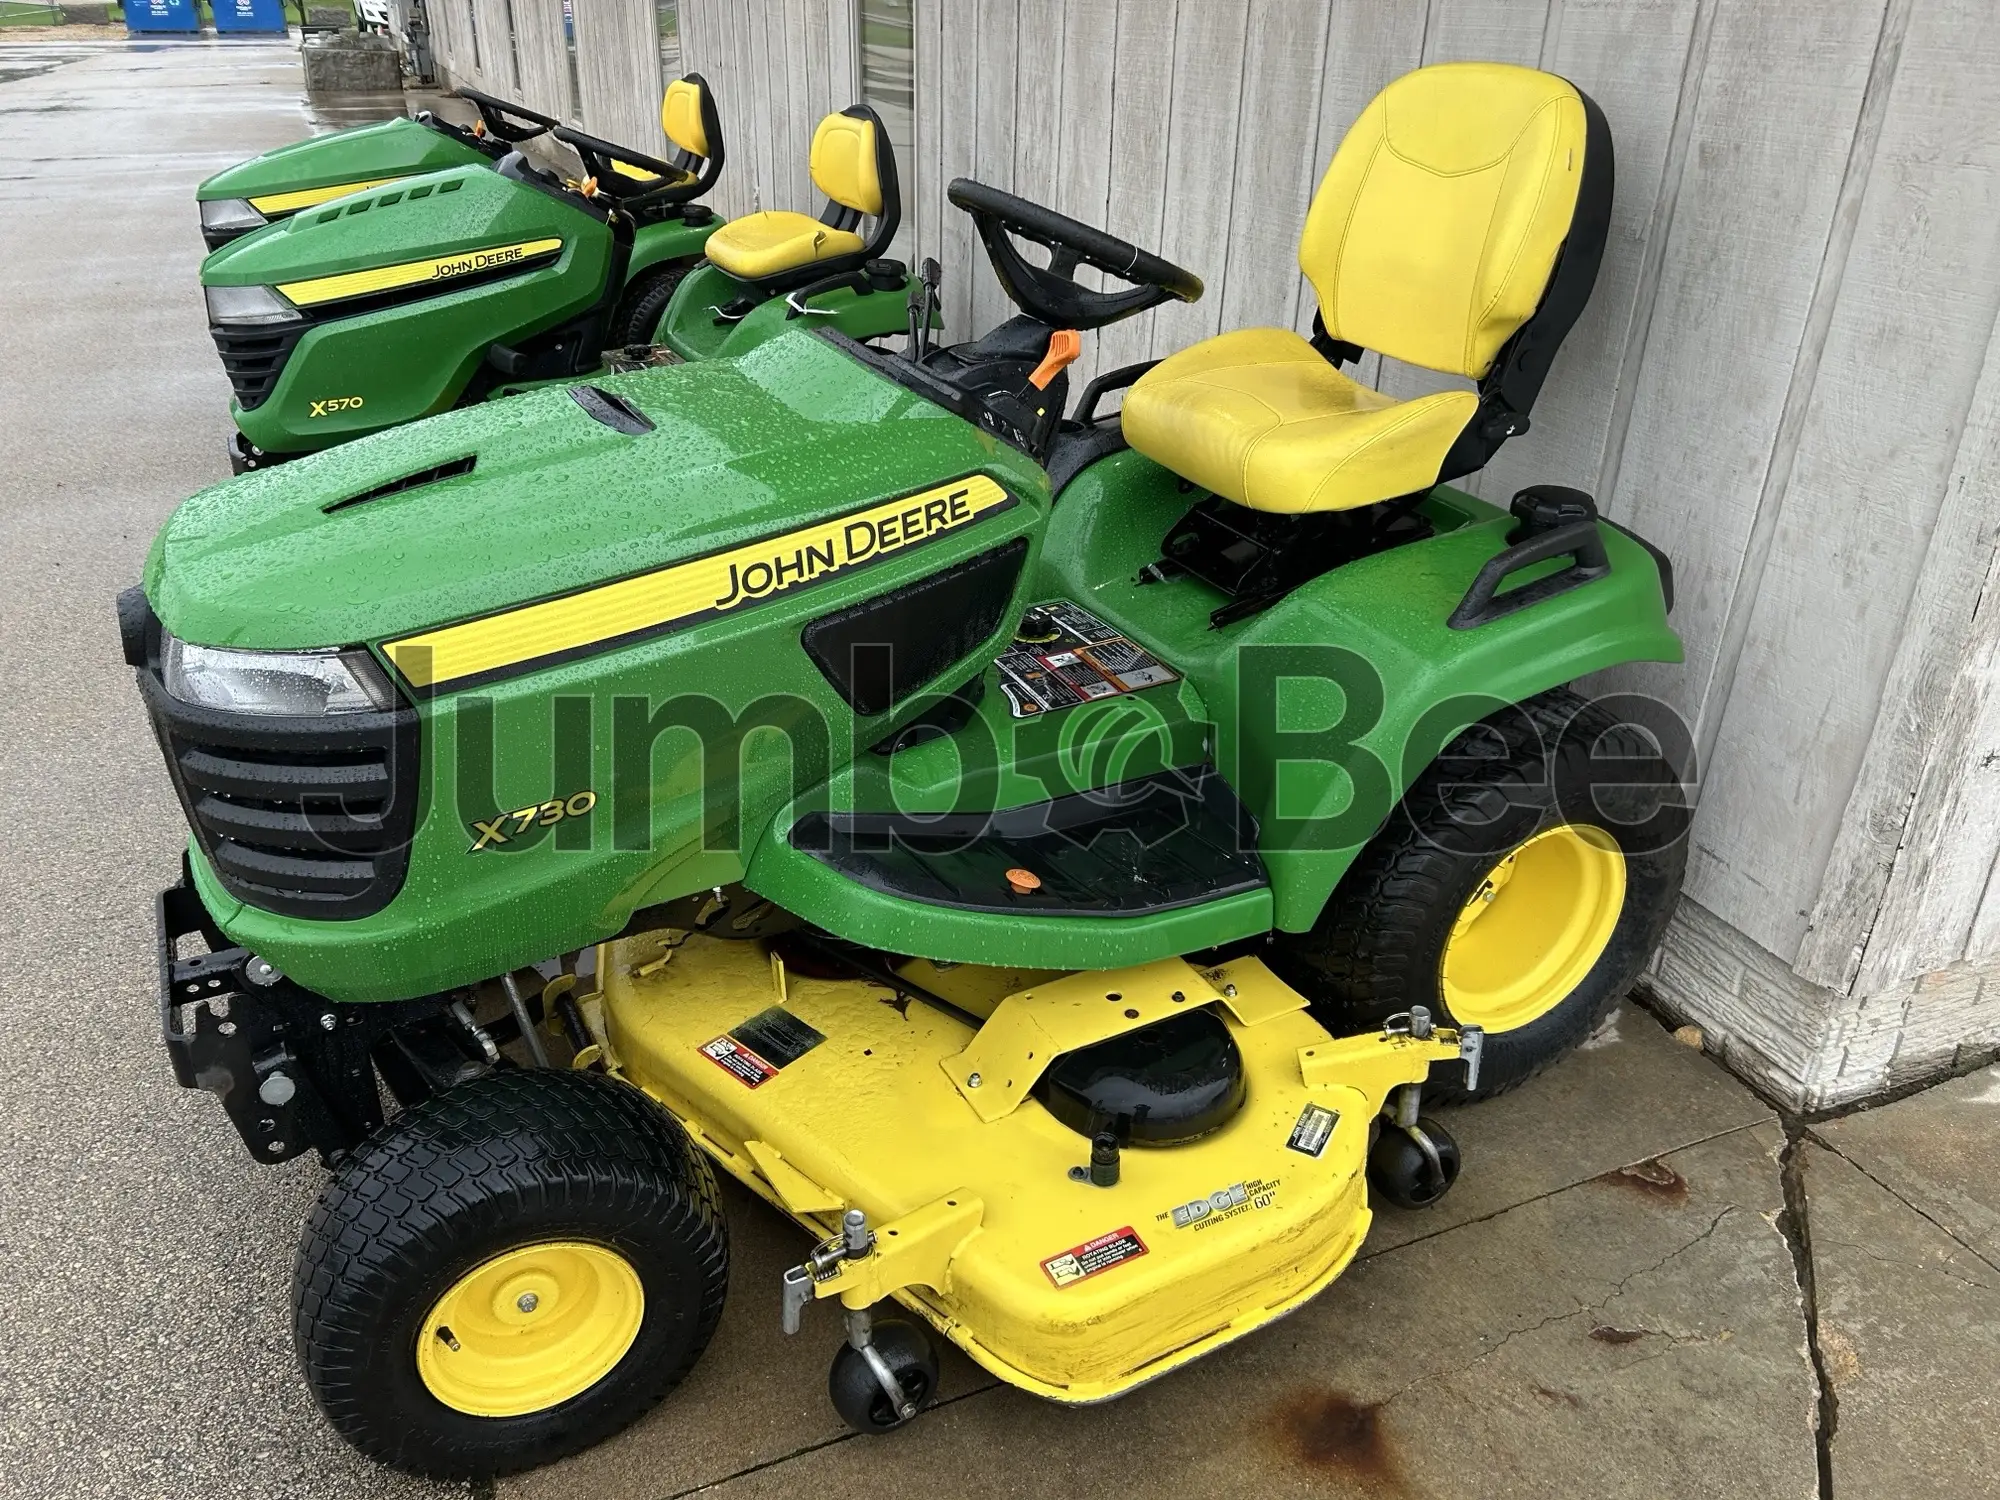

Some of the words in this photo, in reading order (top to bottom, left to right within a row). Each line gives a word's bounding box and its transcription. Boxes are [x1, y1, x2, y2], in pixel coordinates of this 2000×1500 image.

[432, 260, 473, 278] JOHN
[474, 247, 525, 268] DEERE
[309, 396, 363, 418] X570
[716, 539, 835, 606] JOHN
[844, 489, 970, 561] DEERE
[466, 790, 597, 853] X730
[1245, 1179, 1262, 1190] HIGH
[1248, 1179, 1281, 1197] CAPACITY
[1155, 1211, 1170, 1222] THE
[1172, 1183, 1250, 1229] EDGE
[1194, 1214, 1225, 1232] CUTTING
[1090, 1233, 1119, 1248] DANGER
[1082, 1246, 1108, 1260] ROTATING
